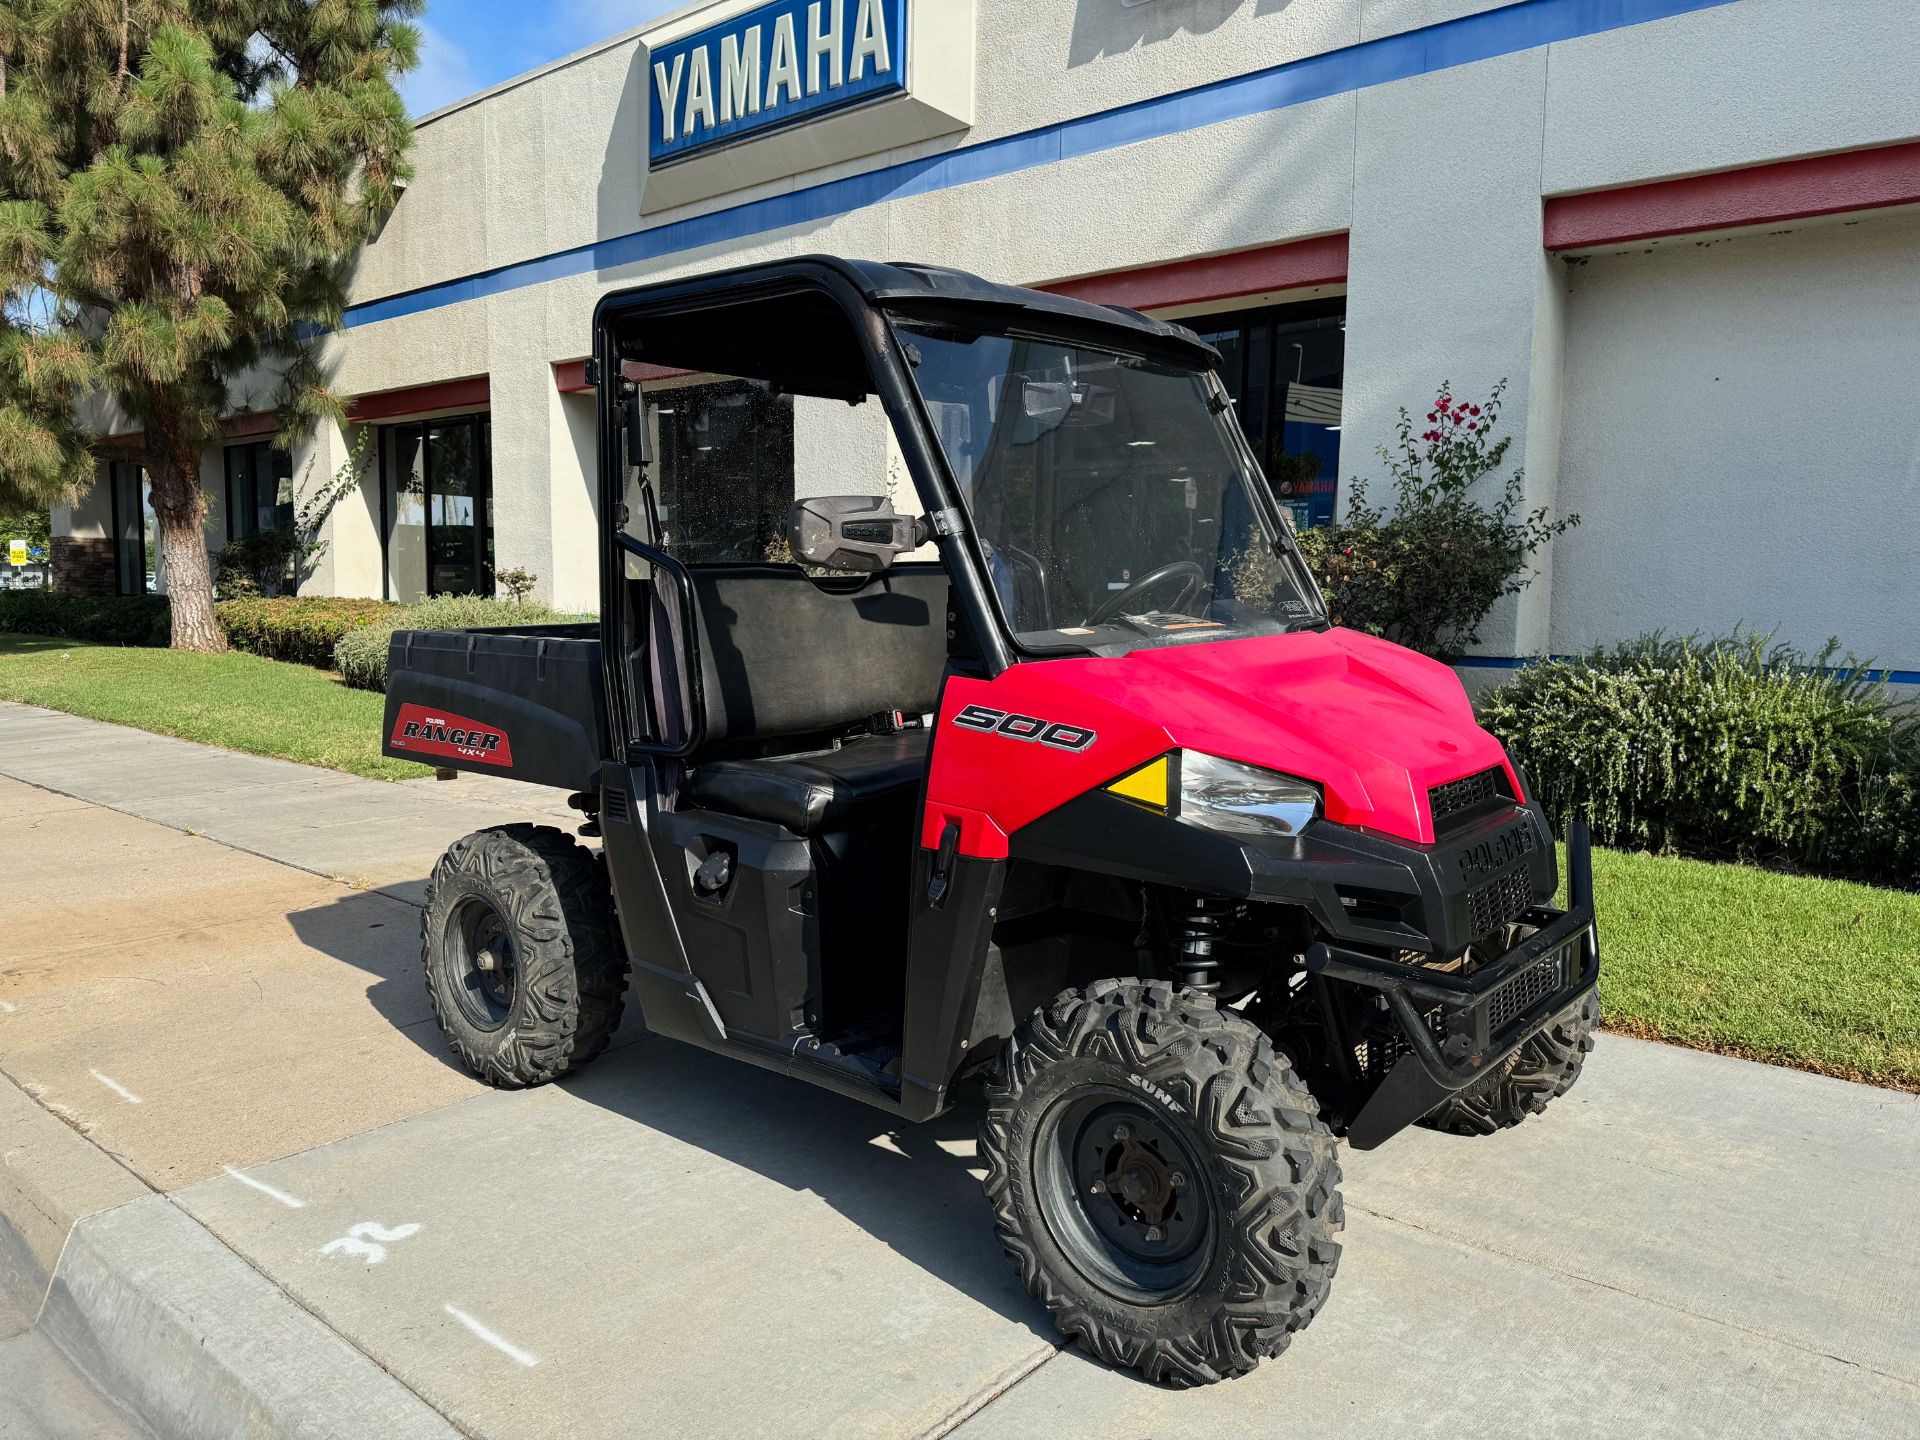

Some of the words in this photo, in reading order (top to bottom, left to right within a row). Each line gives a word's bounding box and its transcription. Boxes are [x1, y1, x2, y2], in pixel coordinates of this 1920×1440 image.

[653, 0, 891, 143] YAMAHA
[1293, 481, 1335, 492] YAMAHA
[402, 721, 500, 752] RANGER
[952, 704, 1098, 753] 500
[1458, 822, 1533, 882] POLARIS
